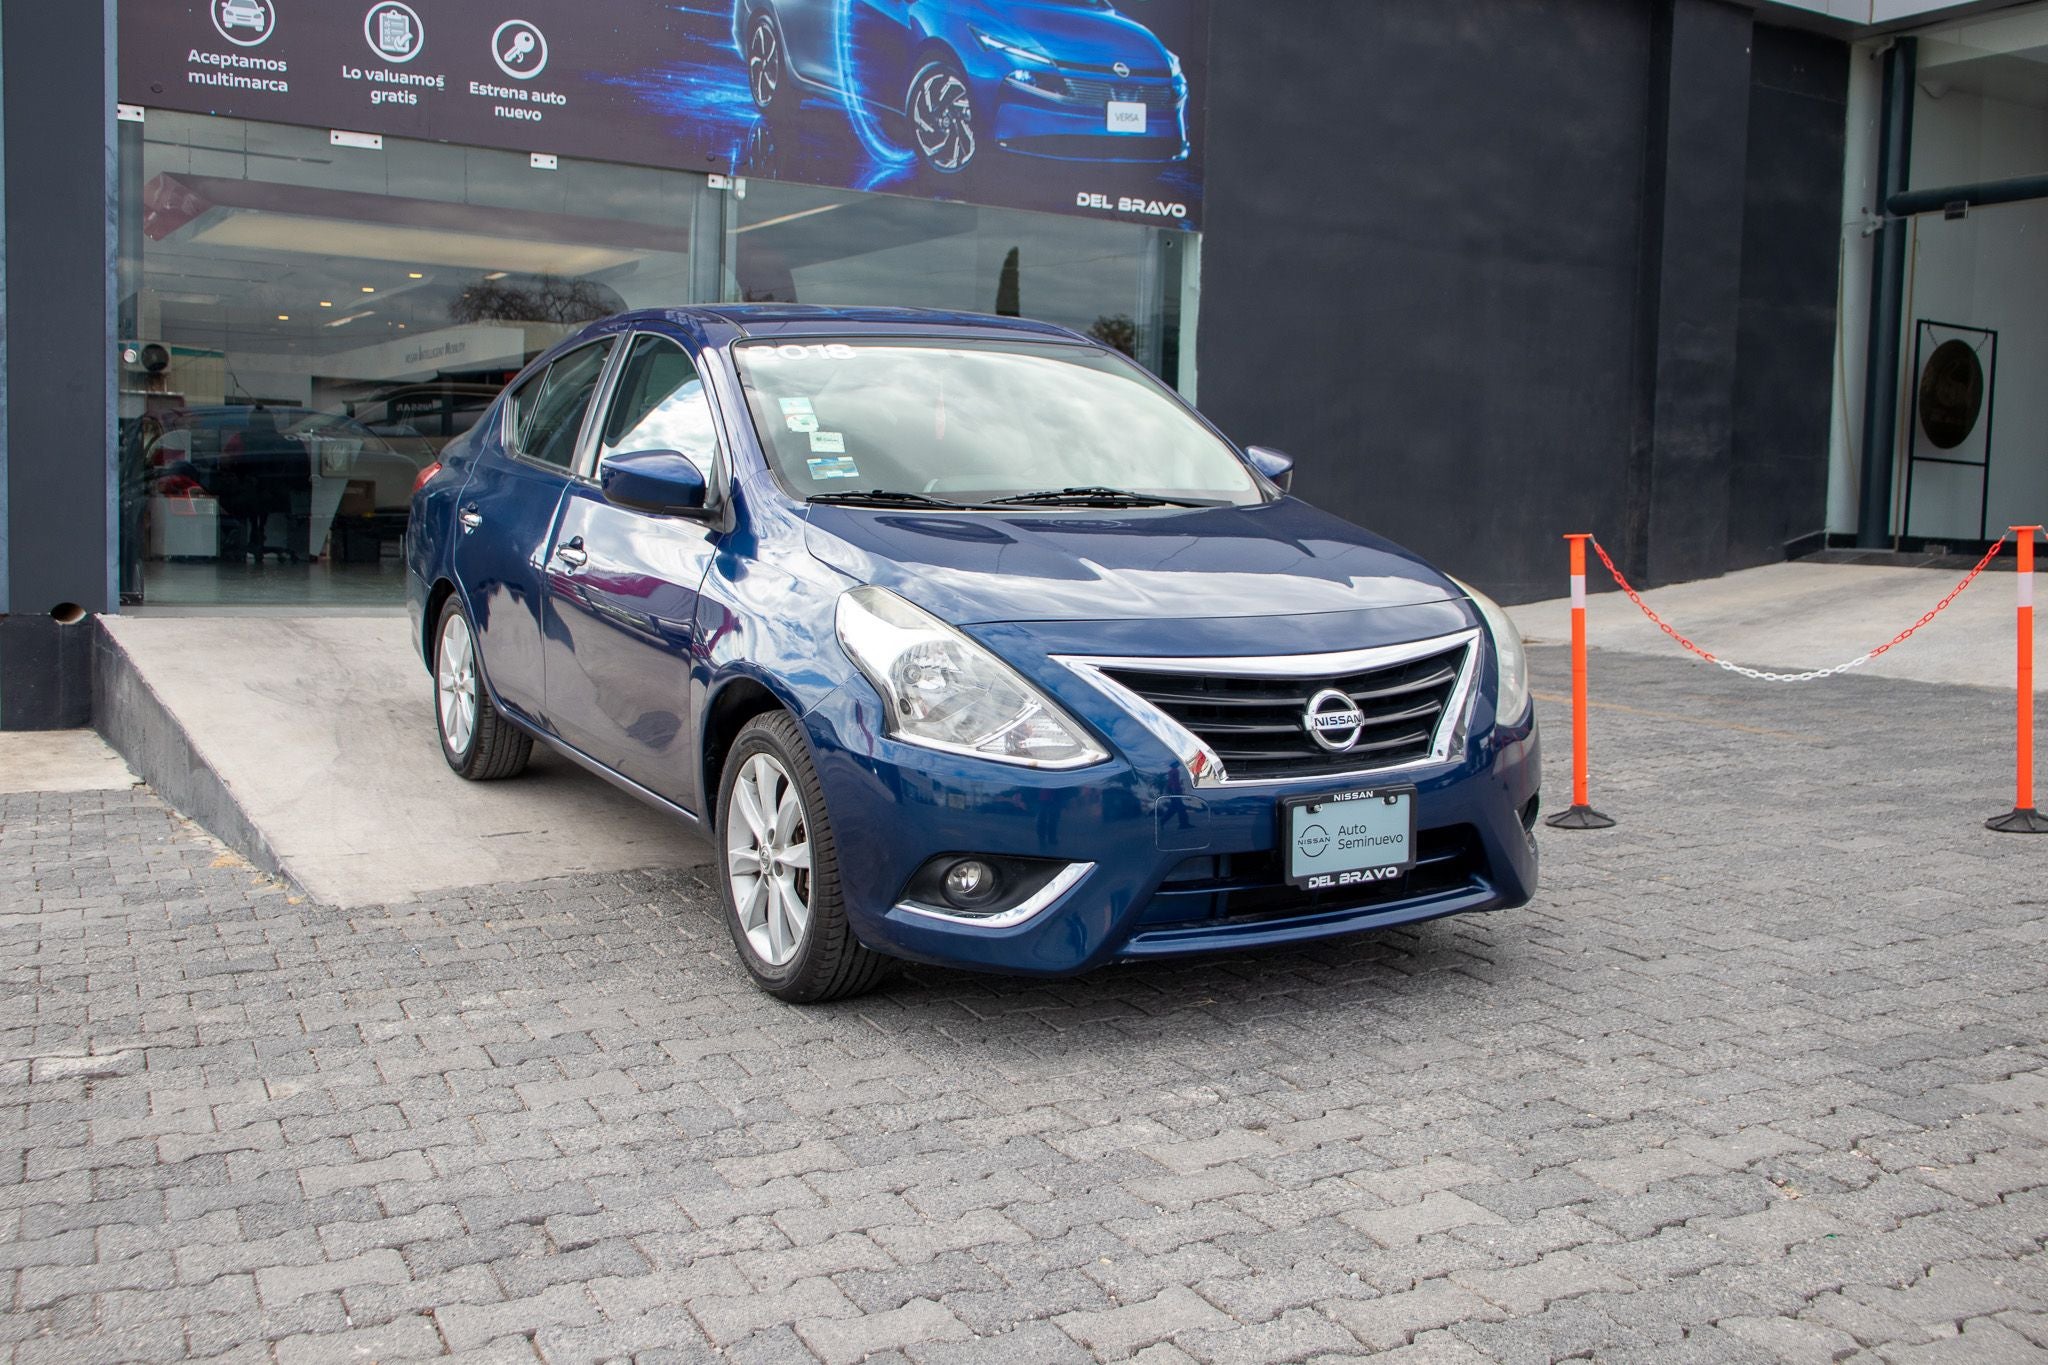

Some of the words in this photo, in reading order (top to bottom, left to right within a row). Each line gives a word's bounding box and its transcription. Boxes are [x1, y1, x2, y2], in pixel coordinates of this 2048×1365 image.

[188, 49, 287, 73] Aceptamos
[188, 70, 289, 93] multimarca
[342, 65, 361, 80] Lo
[365, 69, 445, 89] valuamos
[370, 88, 418, 105] gratis
[469, 81, 528, 101] Estrena
[531, 91, 567, 105] auto
[495, 105, 542, 121] nuevo
[1114, 113, 1139, 122] VERSA
[1076, 192, 1113, 209] DEL
[1118, 197, 1187, 218] BRAVO
[747, 344, 857, 362] 2018
[1314, 713, 1362, 727] NISSAN
[1333, 790, 1374, 802] NISSAN
[1337, 823, 1367, 837] Auto
[1297, 836, 1331, 846] NISSAN
[1337, 832, 1404, 850] Seminuevo
[1308, 875, 1335, 889] DEL
[1339, 866, 1398, 884] BRAVO
